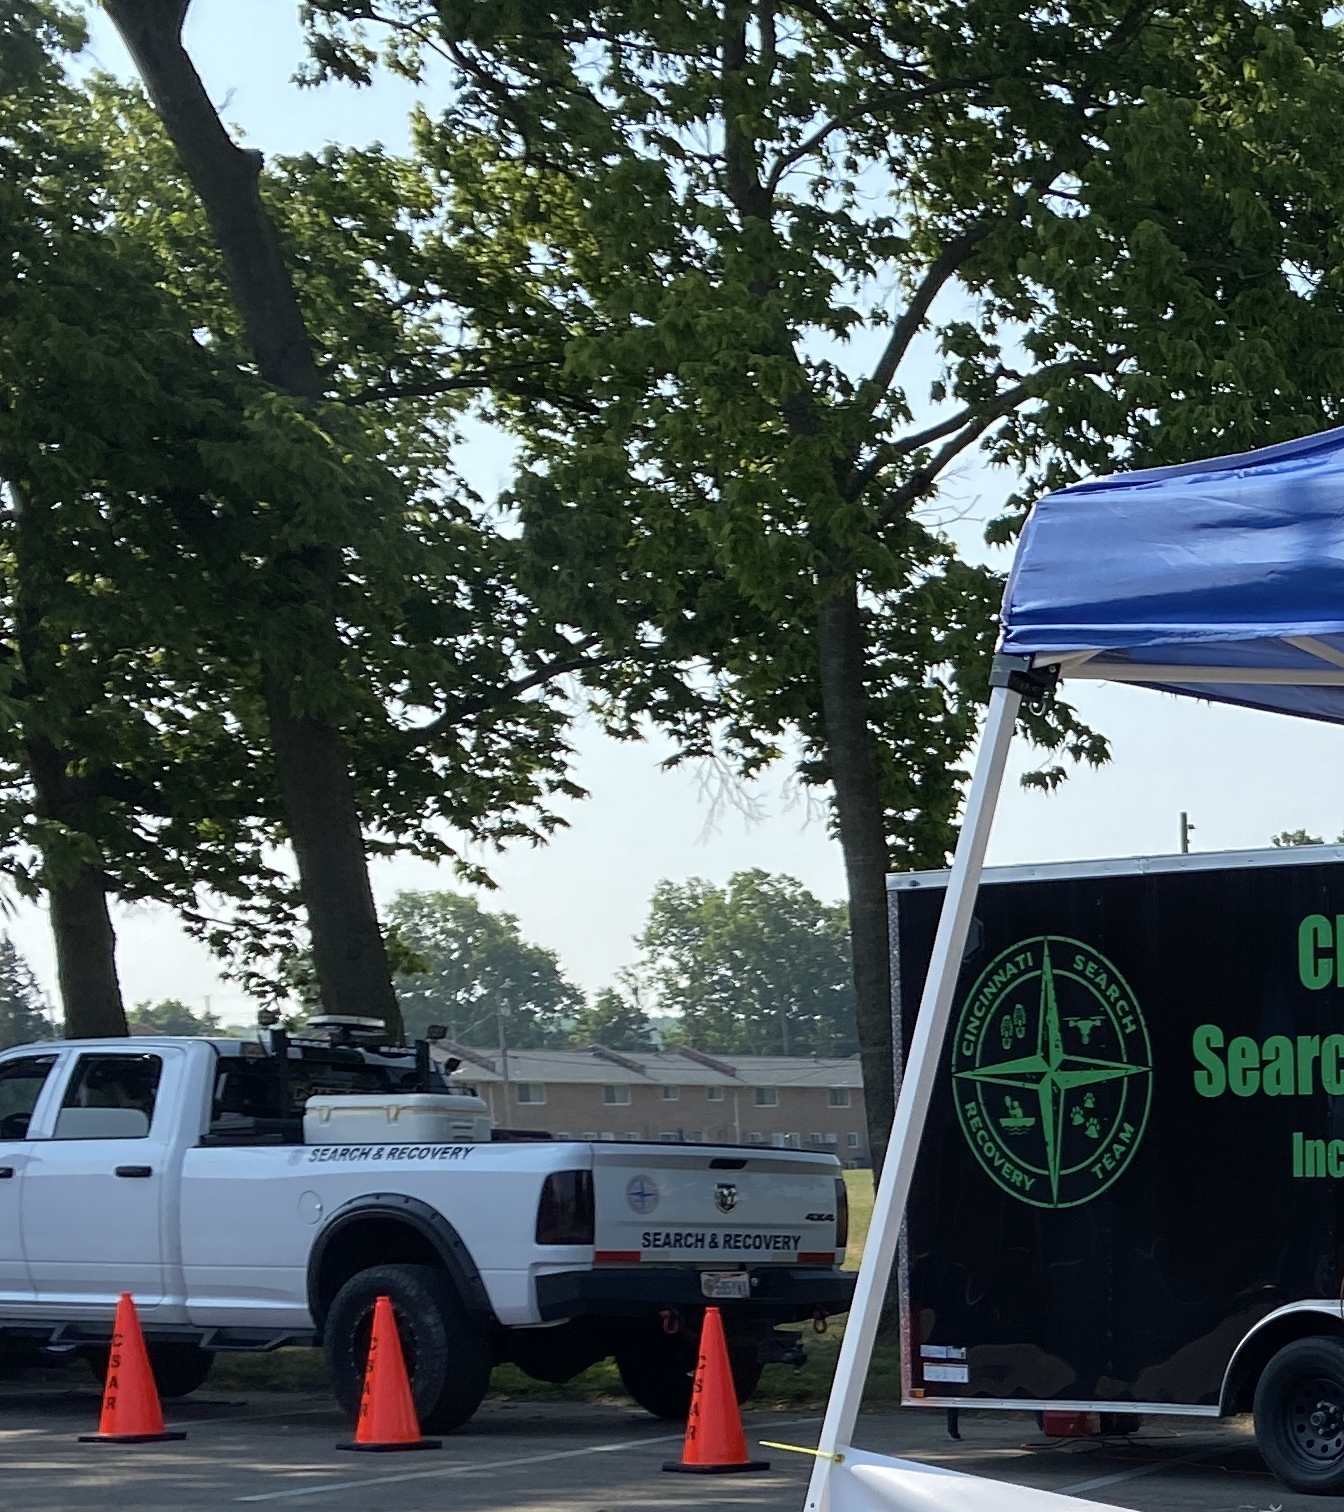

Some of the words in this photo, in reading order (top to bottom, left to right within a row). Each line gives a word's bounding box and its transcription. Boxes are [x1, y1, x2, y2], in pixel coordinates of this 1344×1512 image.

[961, 952, 1034, 1056] CINCINNATI
[1073, 954, 1137, 1034] SEARCH
[308, 1147, 368, 1162] SEARCH
[371, 1147, 382, 1160] &
[386, 1146, 476, 1161] RECOVERY
[964, 1101, 1036, 1191] RECOVERY
[1091, 1122, 1135, 1180] TEAM
[642, 1231, 702, 1248] SEARCH
[708, 1233, 719, 1248] &
[723, 1233, 801, 1250] RECOVERY
